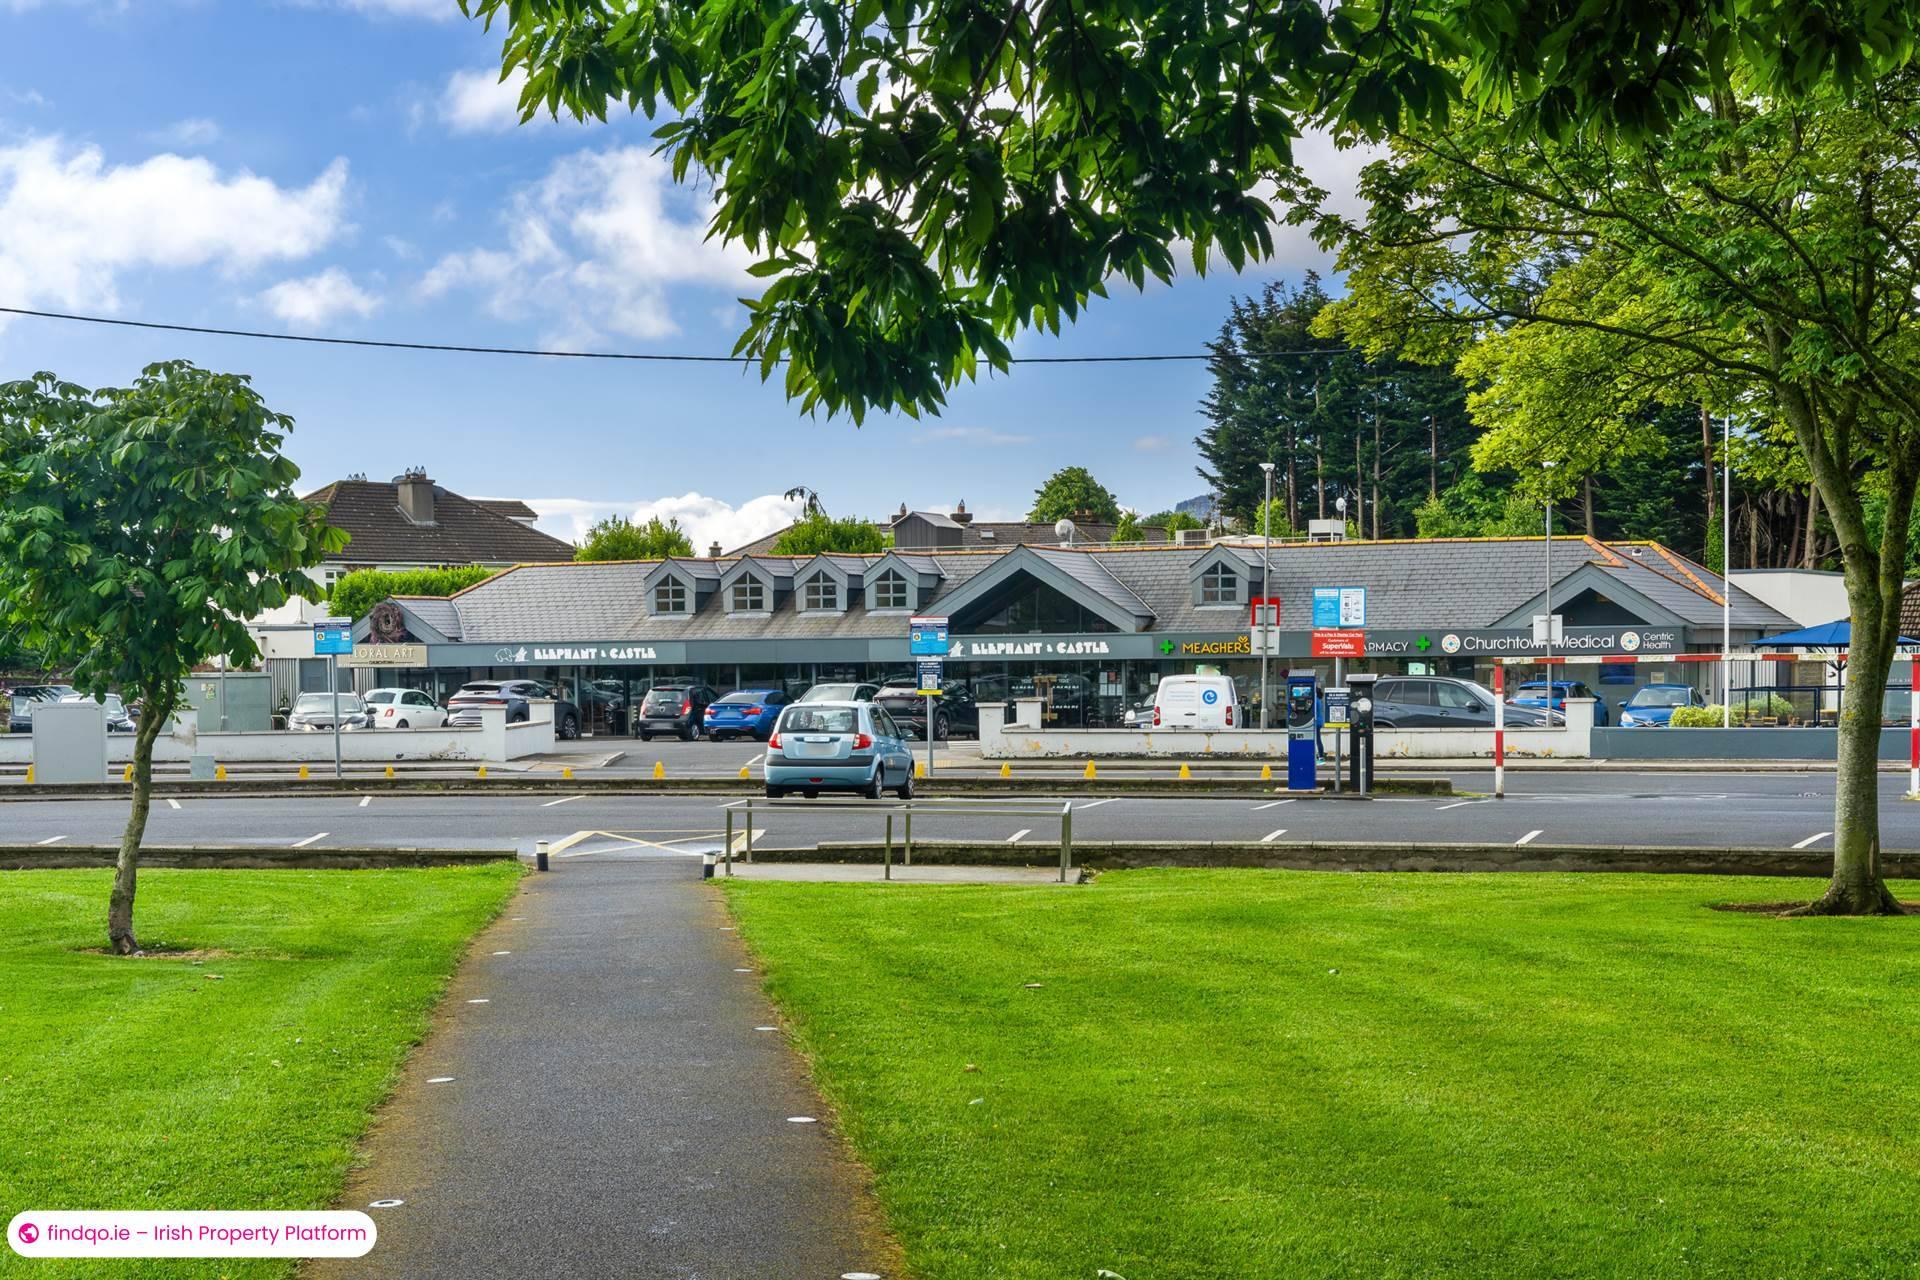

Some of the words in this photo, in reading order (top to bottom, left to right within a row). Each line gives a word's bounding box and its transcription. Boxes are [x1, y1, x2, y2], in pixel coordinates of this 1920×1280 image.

[1556, 634, 1614, 648] Medical
[1643, 632, 1674, 640] Centric
[972, 642, 1042, 655] ELEPHANT
[1056, 642, 1110, 654] CASTLE
[1643, 640, 1672, 649] Health
[350, 647, 388, 658] LORAL
[394, 648, 415, 658] ART
[534, 648, 598, 660] ELEPHANT
[610, 648, 656, 659] CASTLE
